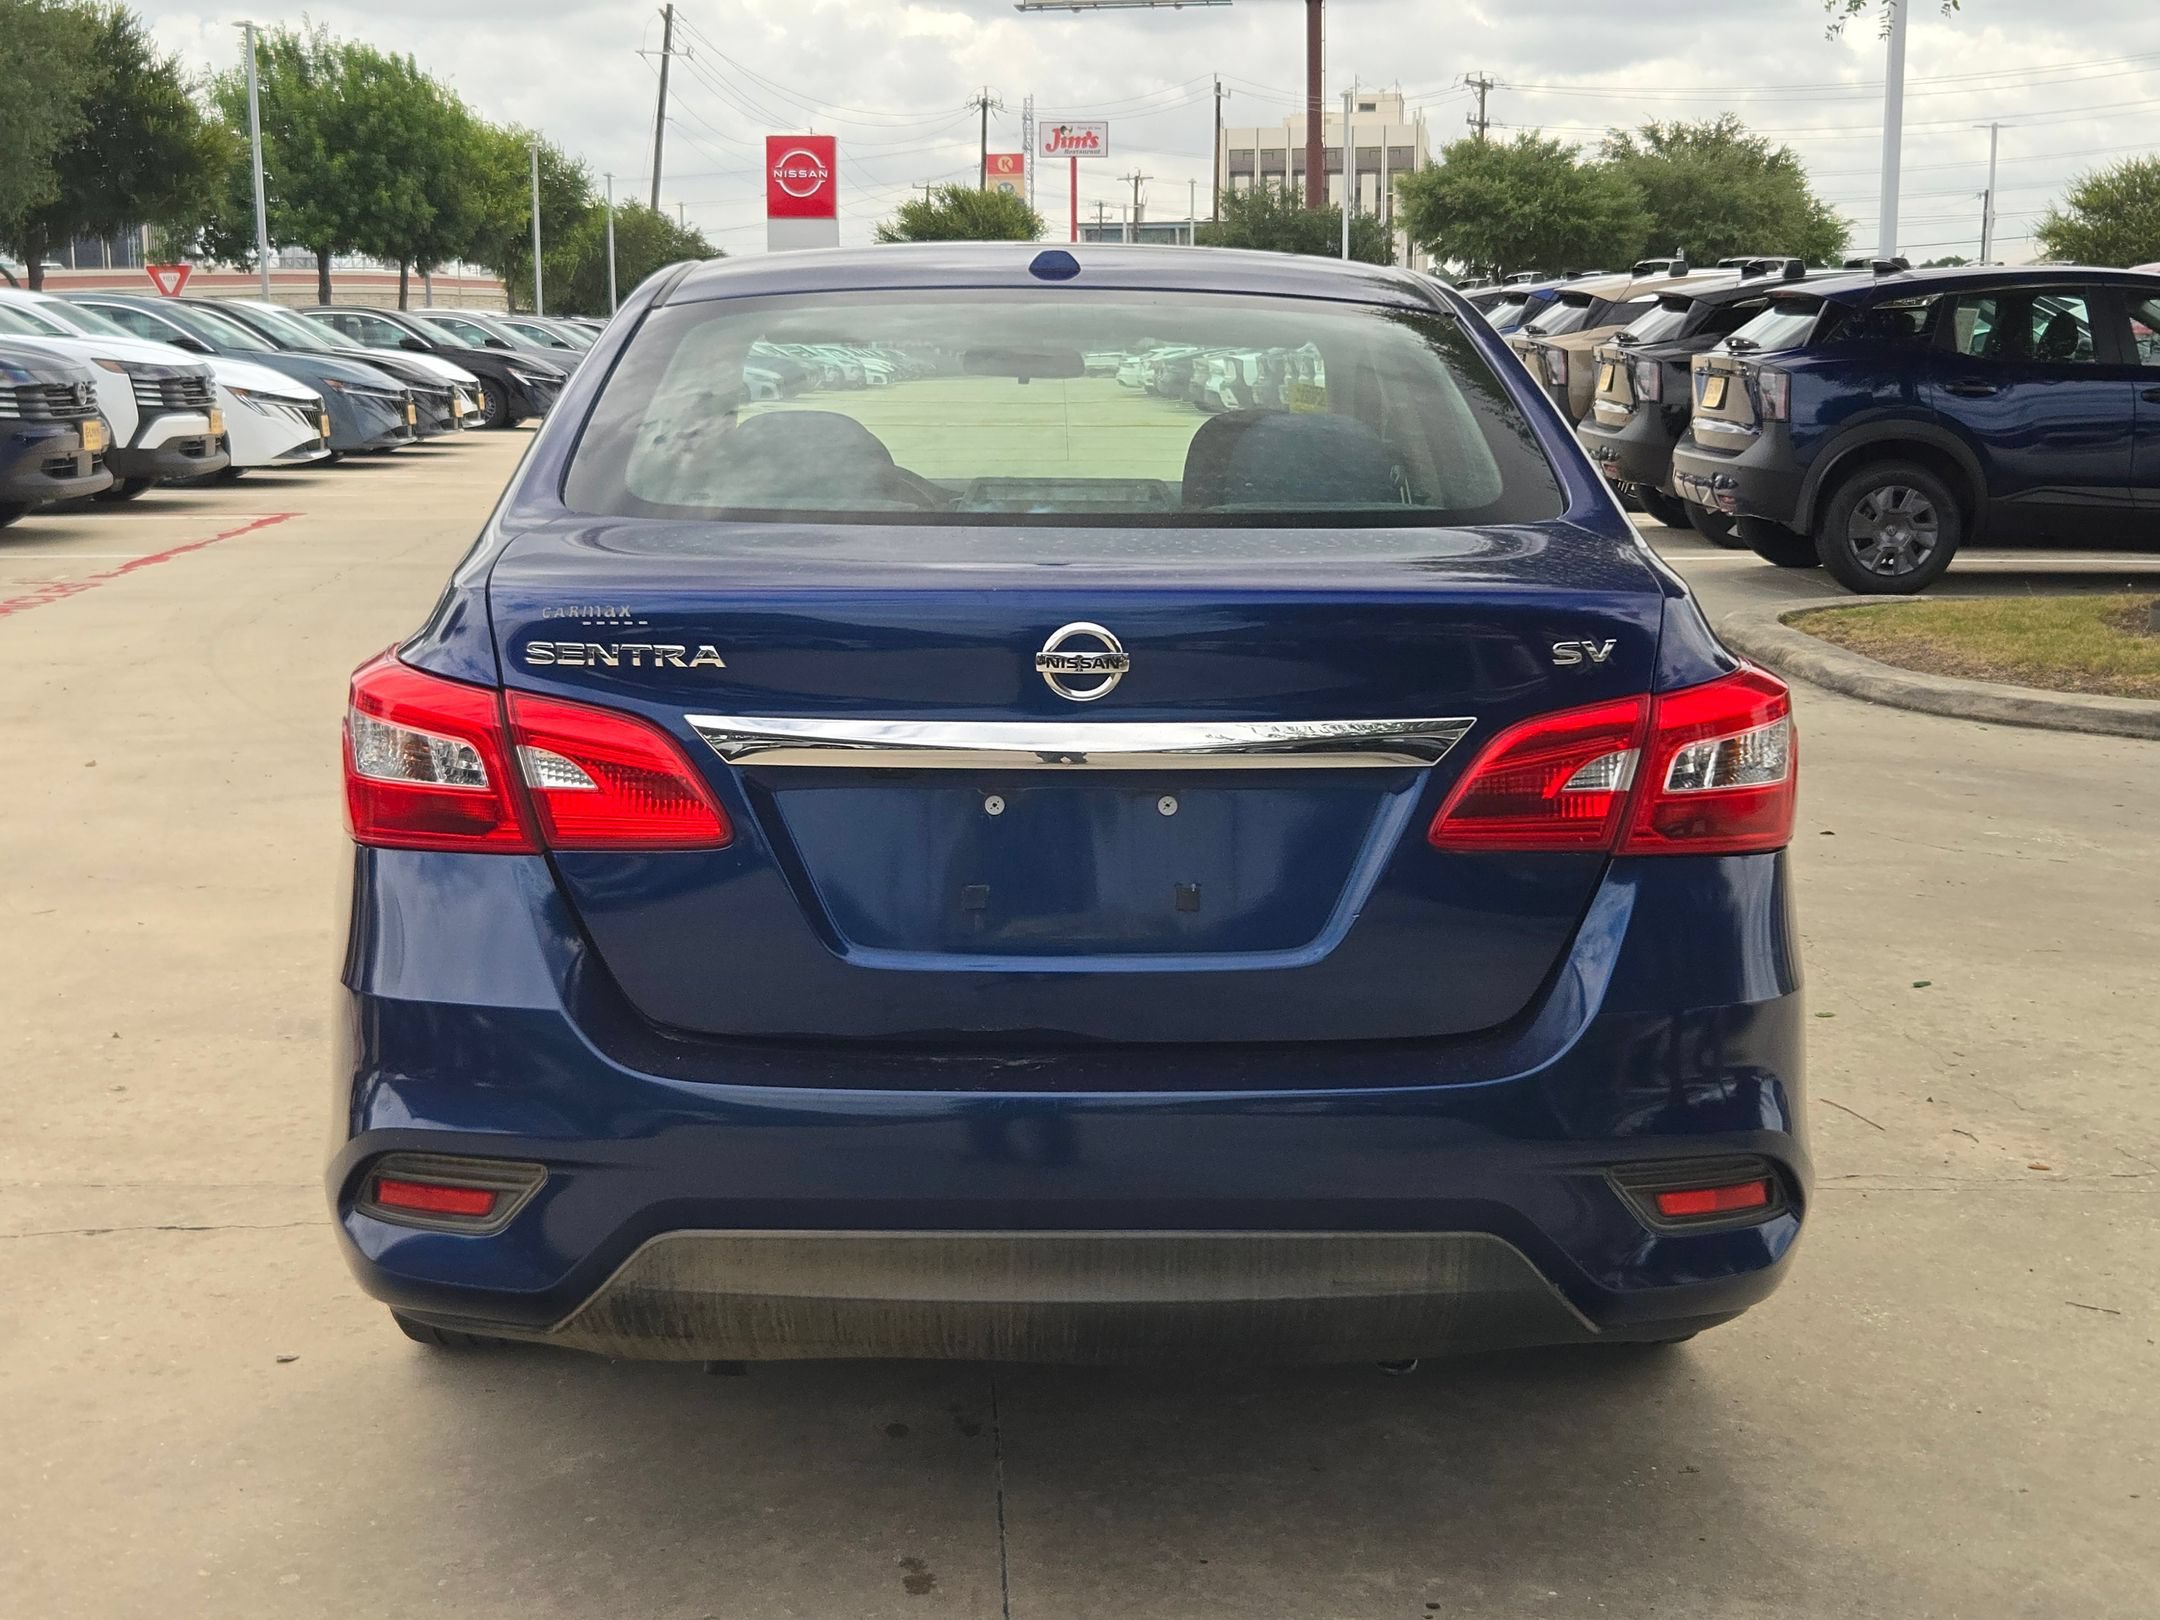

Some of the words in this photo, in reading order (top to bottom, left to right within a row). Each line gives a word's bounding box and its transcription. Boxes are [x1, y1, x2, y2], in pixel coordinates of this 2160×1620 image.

[1001, 159, 1011, 171] K
[773, 169, 828, 178] NISSAN
[526, 641, 727, 668] SENTRA
[1552, 639, 1617, 665] SV
[1046, 657, 1120, 669] NISSAN
